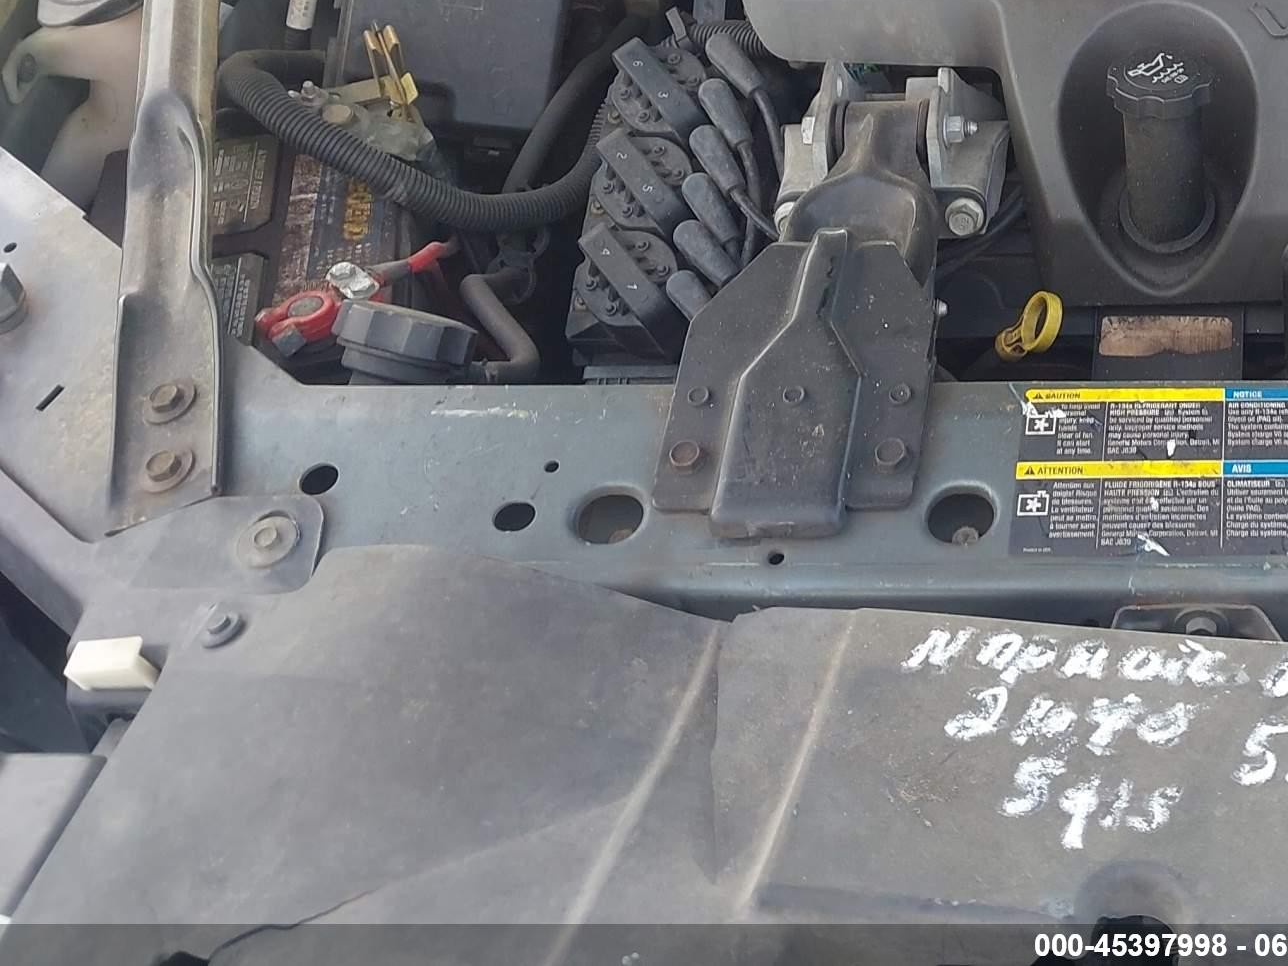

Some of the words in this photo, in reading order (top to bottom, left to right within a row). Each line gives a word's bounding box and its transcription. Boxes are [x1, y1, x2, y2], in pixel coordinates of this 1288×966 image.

[658, 90, 669, 99] 3
[616, 152, 628, 160] 2
[642, 184, 653, 193] 5
[601, 248, 611, 256] 4
[1038, 466, 1084, 474] ATTENTION
[1232, 464, 1252, 473] AVIS
